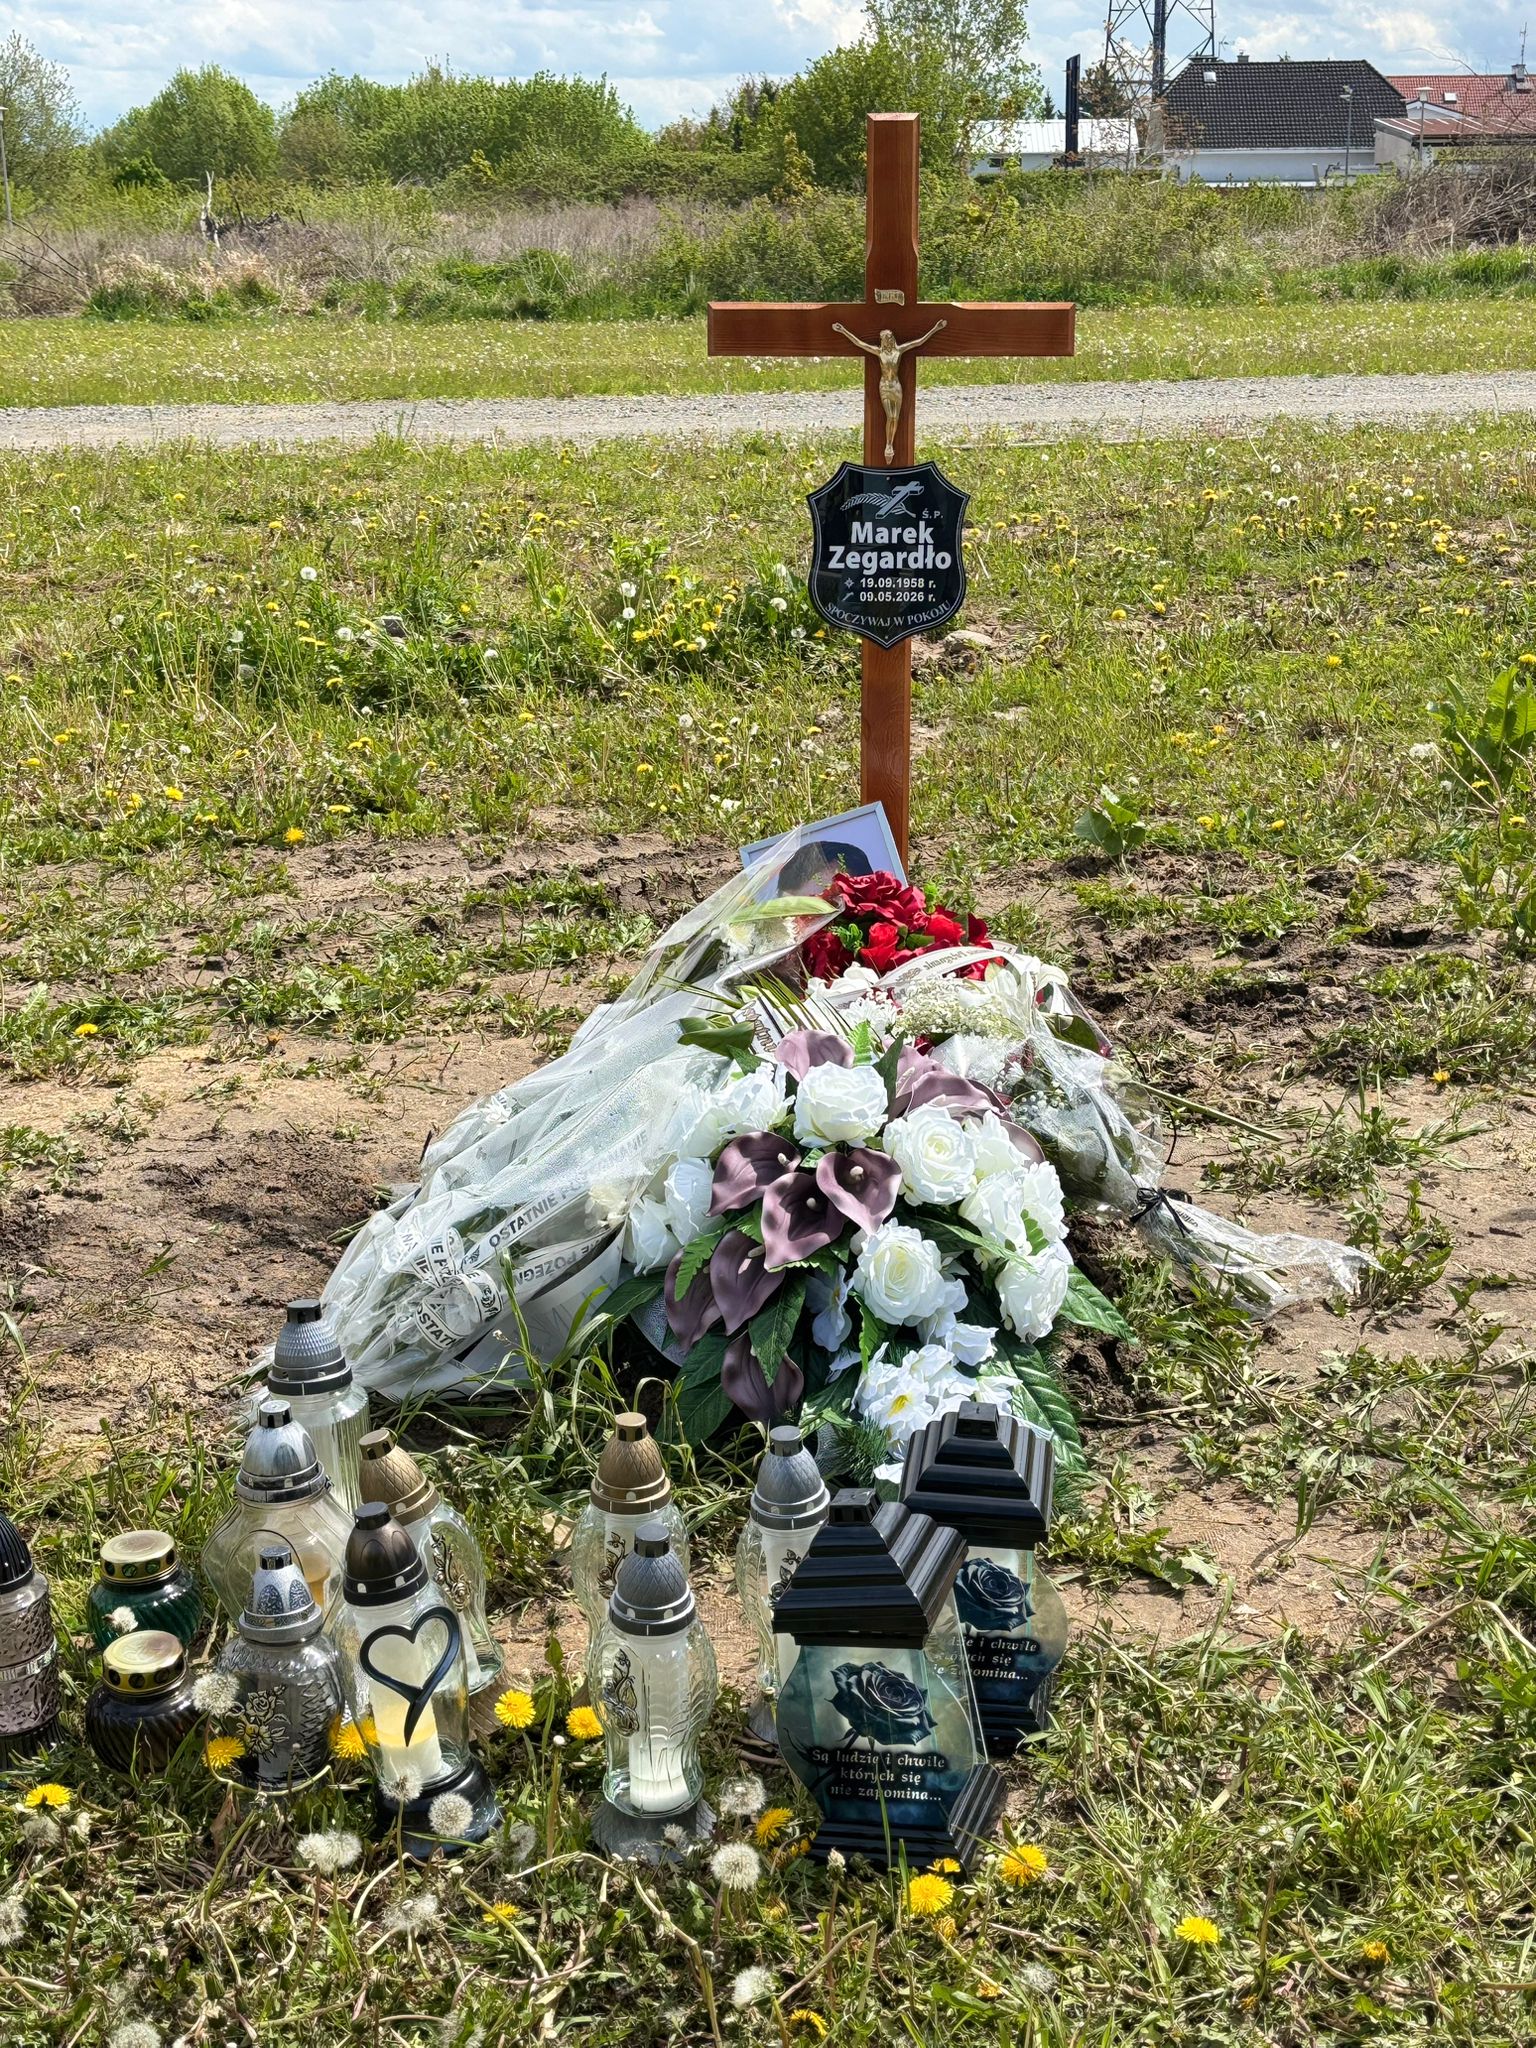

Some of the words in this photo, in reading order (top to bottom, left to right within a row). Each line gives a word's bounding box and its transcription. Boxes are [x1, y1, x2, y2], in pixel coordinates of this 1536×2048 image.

[851, 520, 934, 544] Marek
[827, 544, 952, 576] Zegardło
[860, 577, 925, 589] 19.09.1958
[928, 579, 936, 589] r.
[859, 591, 925, 602] 09.05.2026
[928, 593, 936, 602] r.
[825, 601, 891, 627] SPOCZYWAJ
[893, 616, 905, 627] W
[907, 599, 952, 625] POKOJU
[488, 1192, 560, 1248] OSTATNIE
[992, 1653, 1012, 1667] się
[812, 1749, 829, 1764] Są
[886, 1753, 891, 1765] i
[897, 1753, 945, 1768] chwile
[840, 1767, 894, 1783] których
[901, 1771, 921, 1785] się
[830, 1783, 852, 1796] nie
